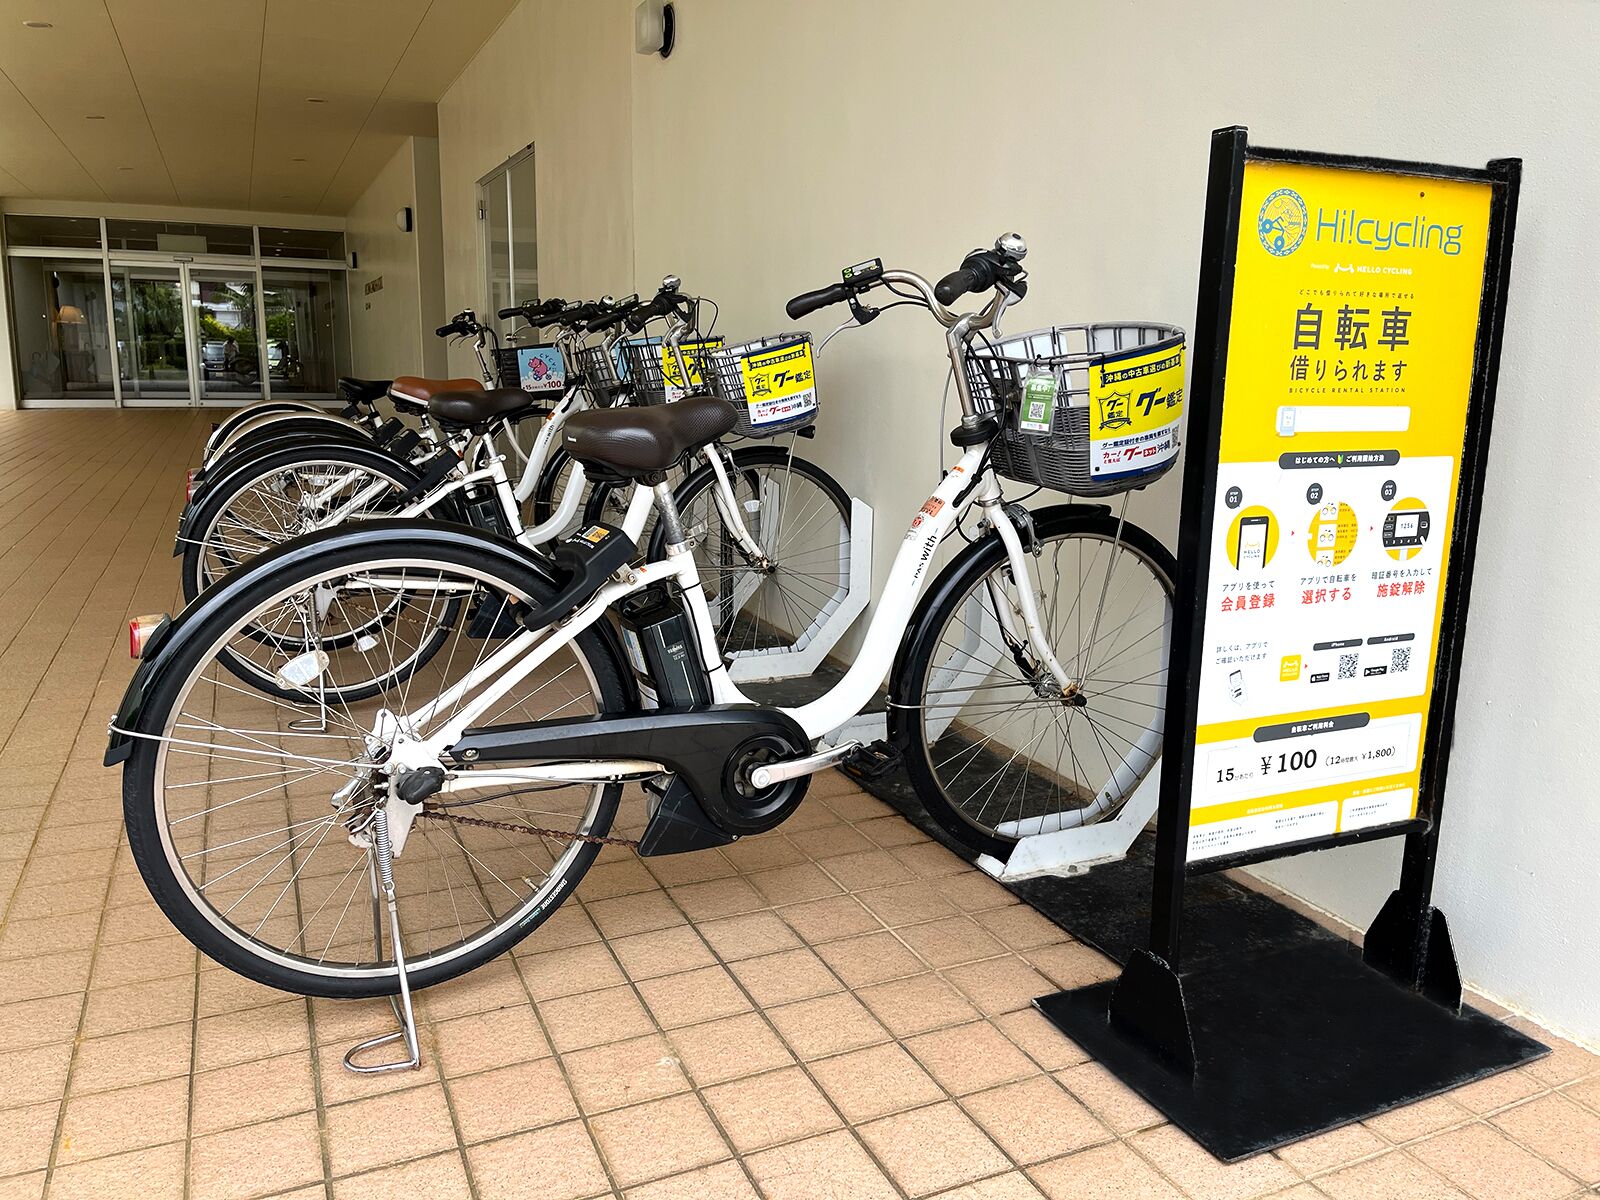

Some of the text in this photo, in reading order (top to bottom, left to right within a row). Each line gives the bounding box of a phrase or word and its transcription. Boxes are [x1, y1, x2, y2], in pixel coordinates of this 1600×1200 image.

[1316, 207, 1464, 255] Hi!cycling
[1357, 265, 1413, 276] HELLO CYCLING
[1293, 302, 1413, 352] 自転車
[1289, 354, 1408, 382] 借りられます
[1135, 387, 1183, 417] グー鑑定
[1295, 455, 1336, 465] はじめての方へ
[1229, 495, 1238, 503] 01
[1310, 492, 1319, 500] 02
[920, 535, 937, 561] with
[1300, 573, 1358, 586] アプリで自転車を
[1371, 567, 1433, 580] 暗証番号を入力して
[1222, 580, 1276, 593] アプリを使って
[1301, 586, 1352, 605] 選択する
[1376, 580, 1426, 598] 施錠解除
[1220, 592, 1276, 613] 会員登録
[1260, 749, 1318, 776] ¥100
